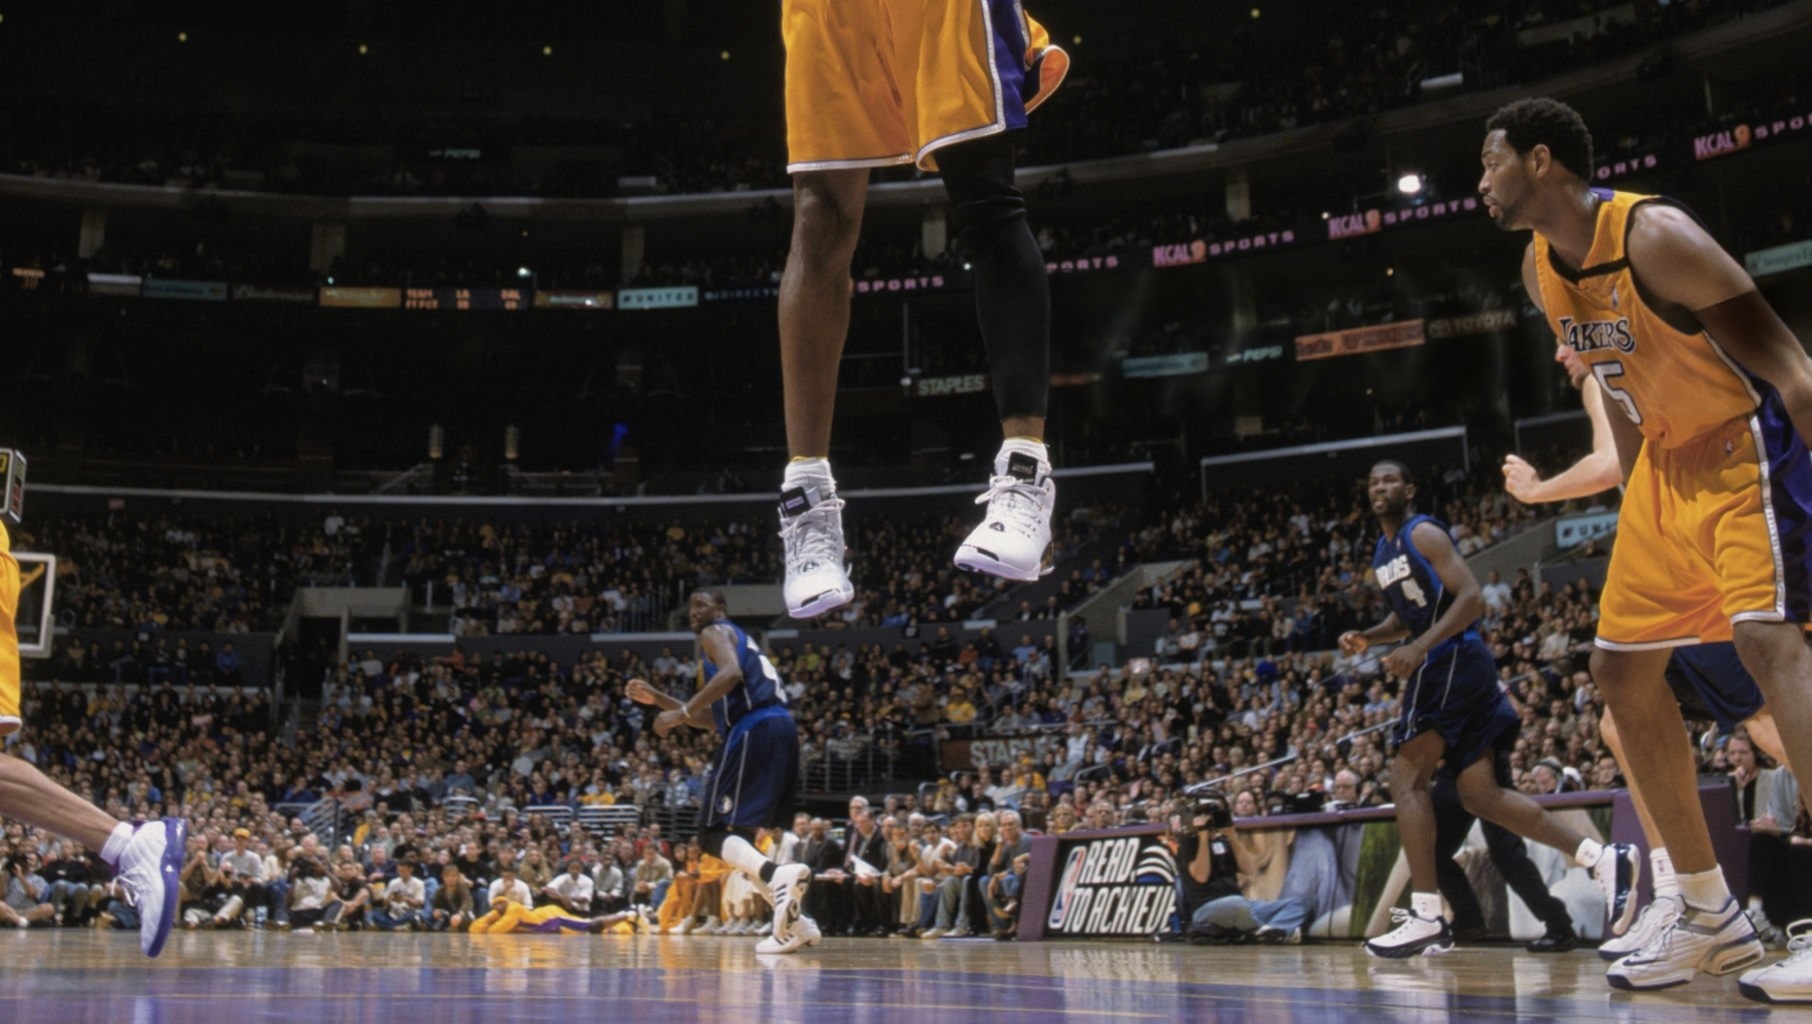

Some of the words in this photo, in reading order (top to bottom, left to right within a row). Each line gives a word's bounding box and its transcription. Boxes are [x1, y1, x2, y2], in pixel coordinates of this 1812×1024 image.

[1328, 208, 1381, 240] KCAL9
[1383, 197, 1477, 225] SPORTS
[1153, 239, 1207, 267] KCAL9
[1209, 229, 1295, 255] SPORTS
[637, 291, 695, 303] UNITED
[857, 276, 944, 293] SPORTS
[917, 374, 985, 397] STAPLES
[1401, 577, 1427, 607] 4
